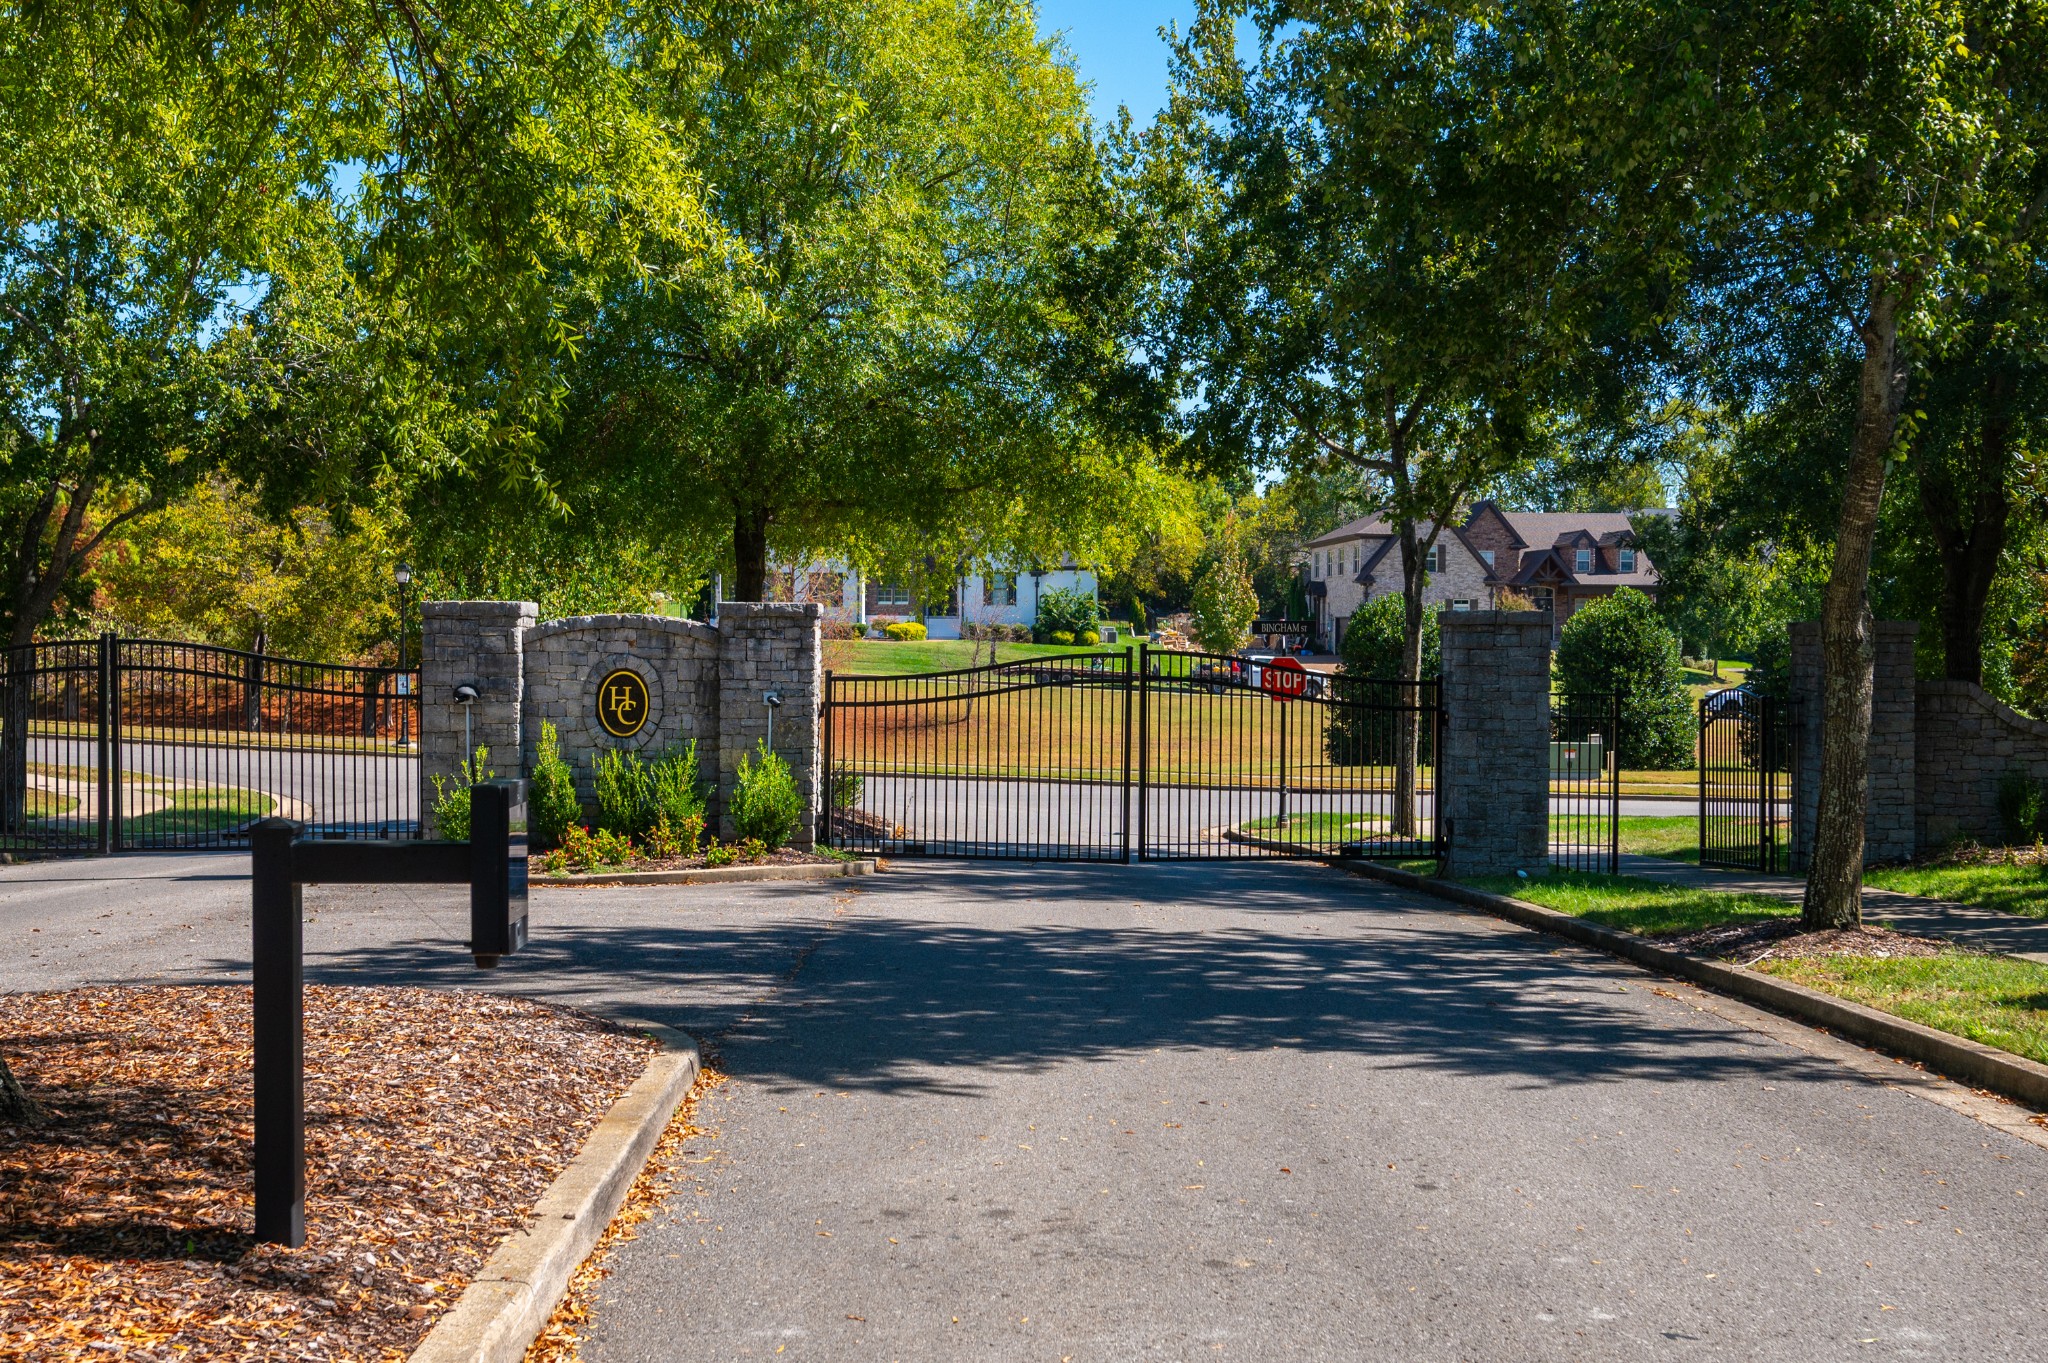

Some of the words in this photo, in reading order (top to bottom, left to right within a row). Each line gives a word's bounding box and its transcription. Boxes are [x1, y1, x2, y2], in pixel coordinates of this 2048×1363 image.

[1261, 623, 1300, 633] BINGHAM
[1300, 625, 1308, 633] ST
[1264, 671, 1302, 689] STOP
